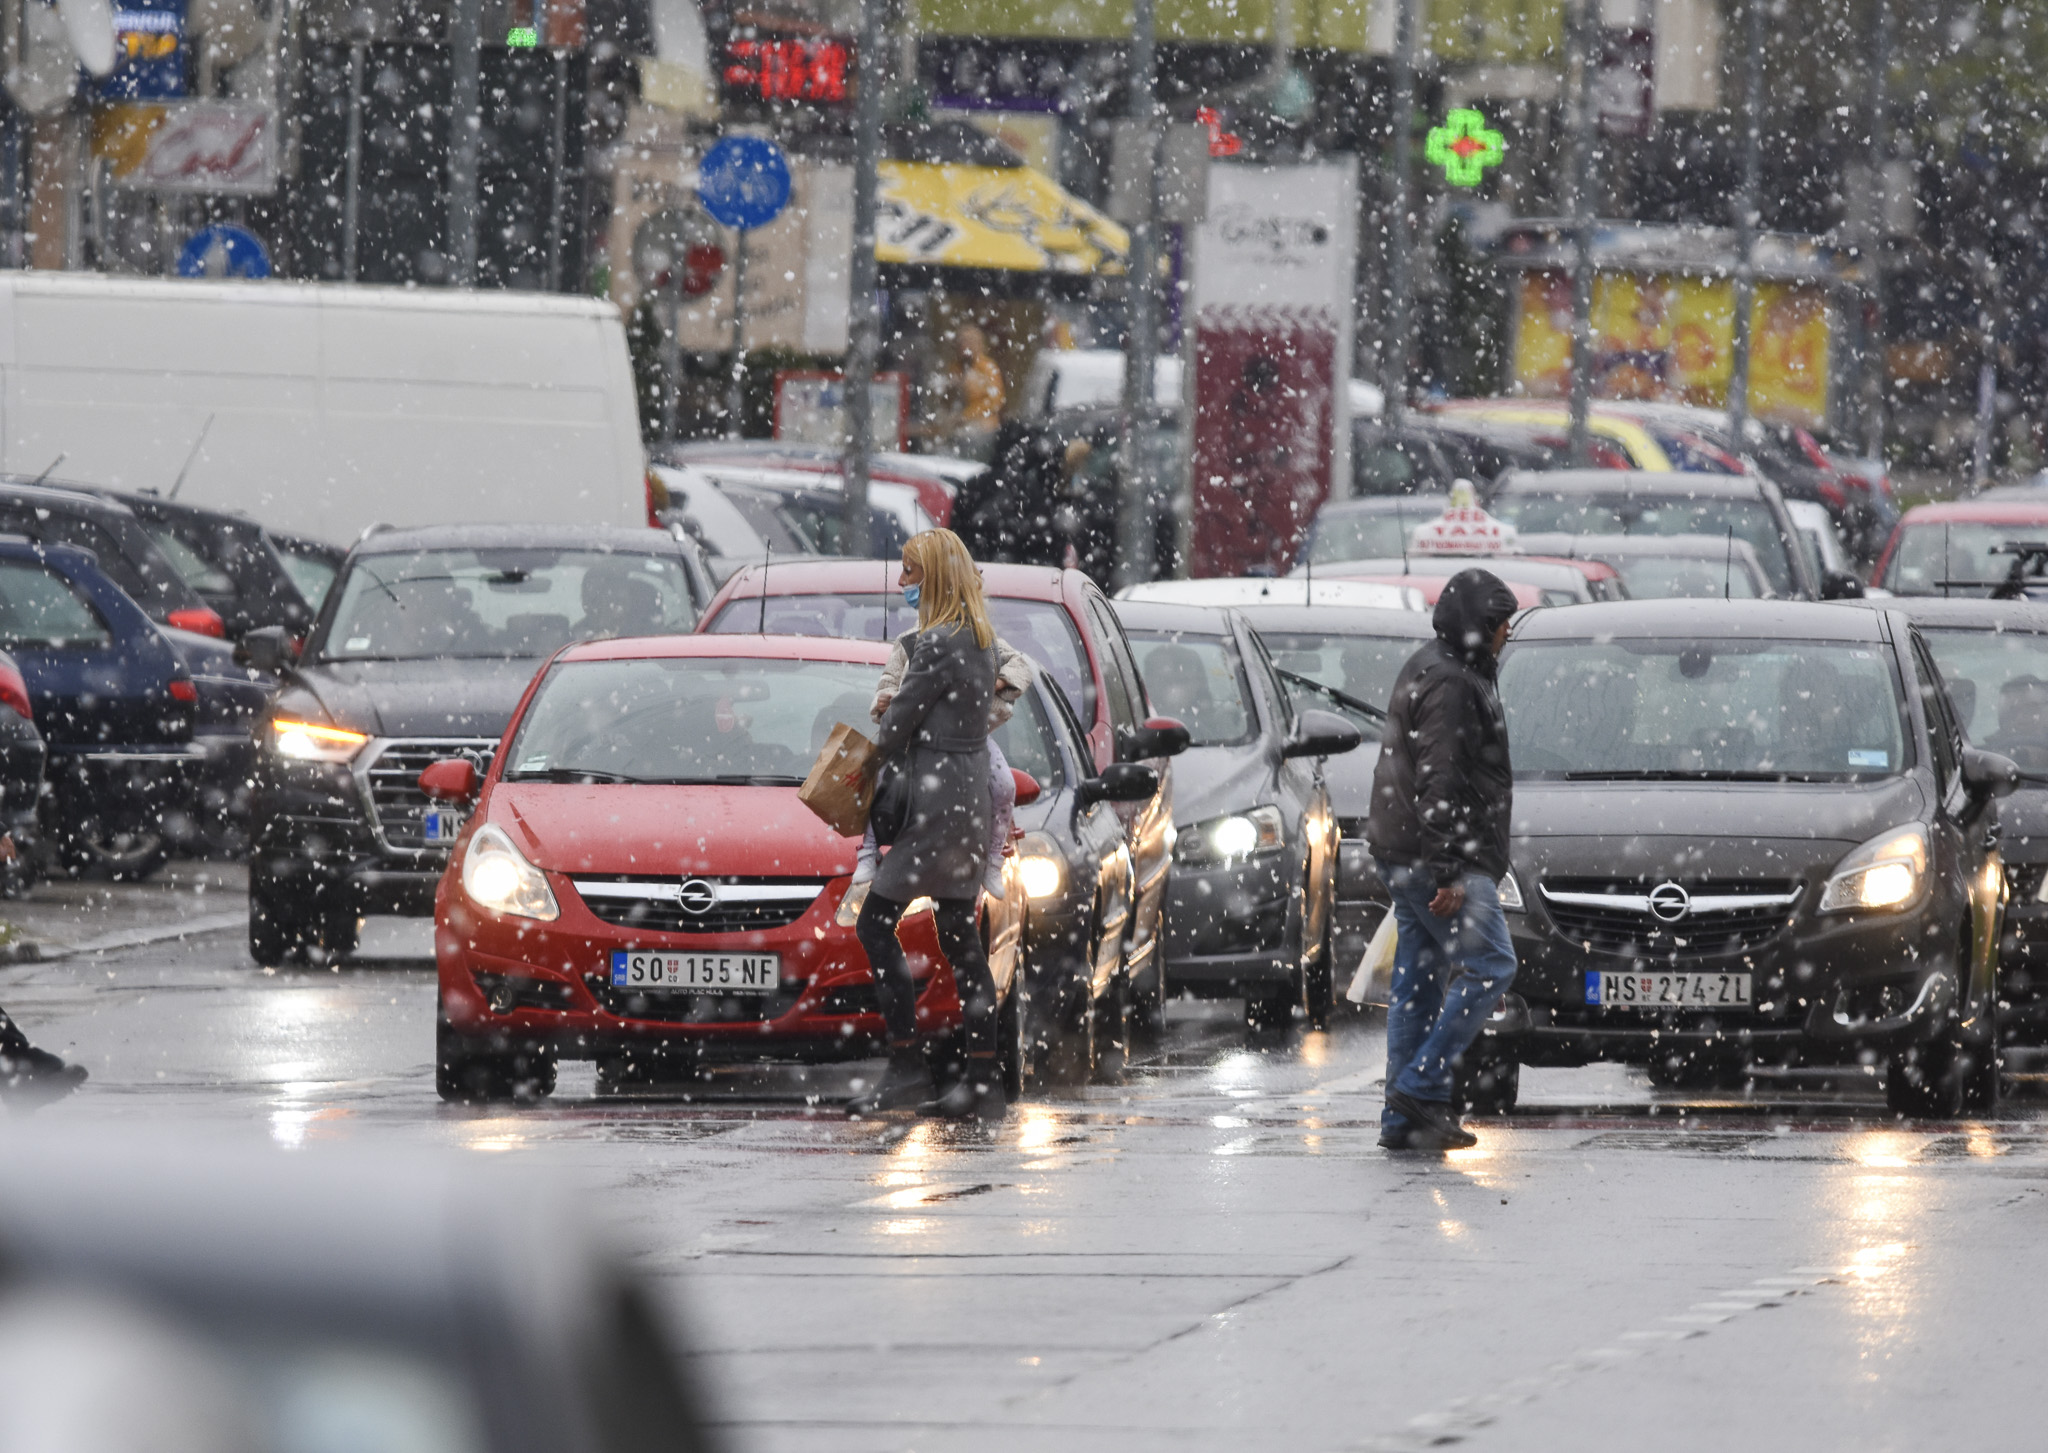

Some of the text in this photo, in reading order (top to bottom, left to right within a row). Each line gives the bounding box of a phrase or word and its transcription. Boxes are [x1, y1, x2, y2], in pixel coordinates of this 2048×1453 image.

[1432, 525, 1499, 537] TAXI
[631, 956, 663, 982] SO
[1605, 975, 1636, 1001] NS
